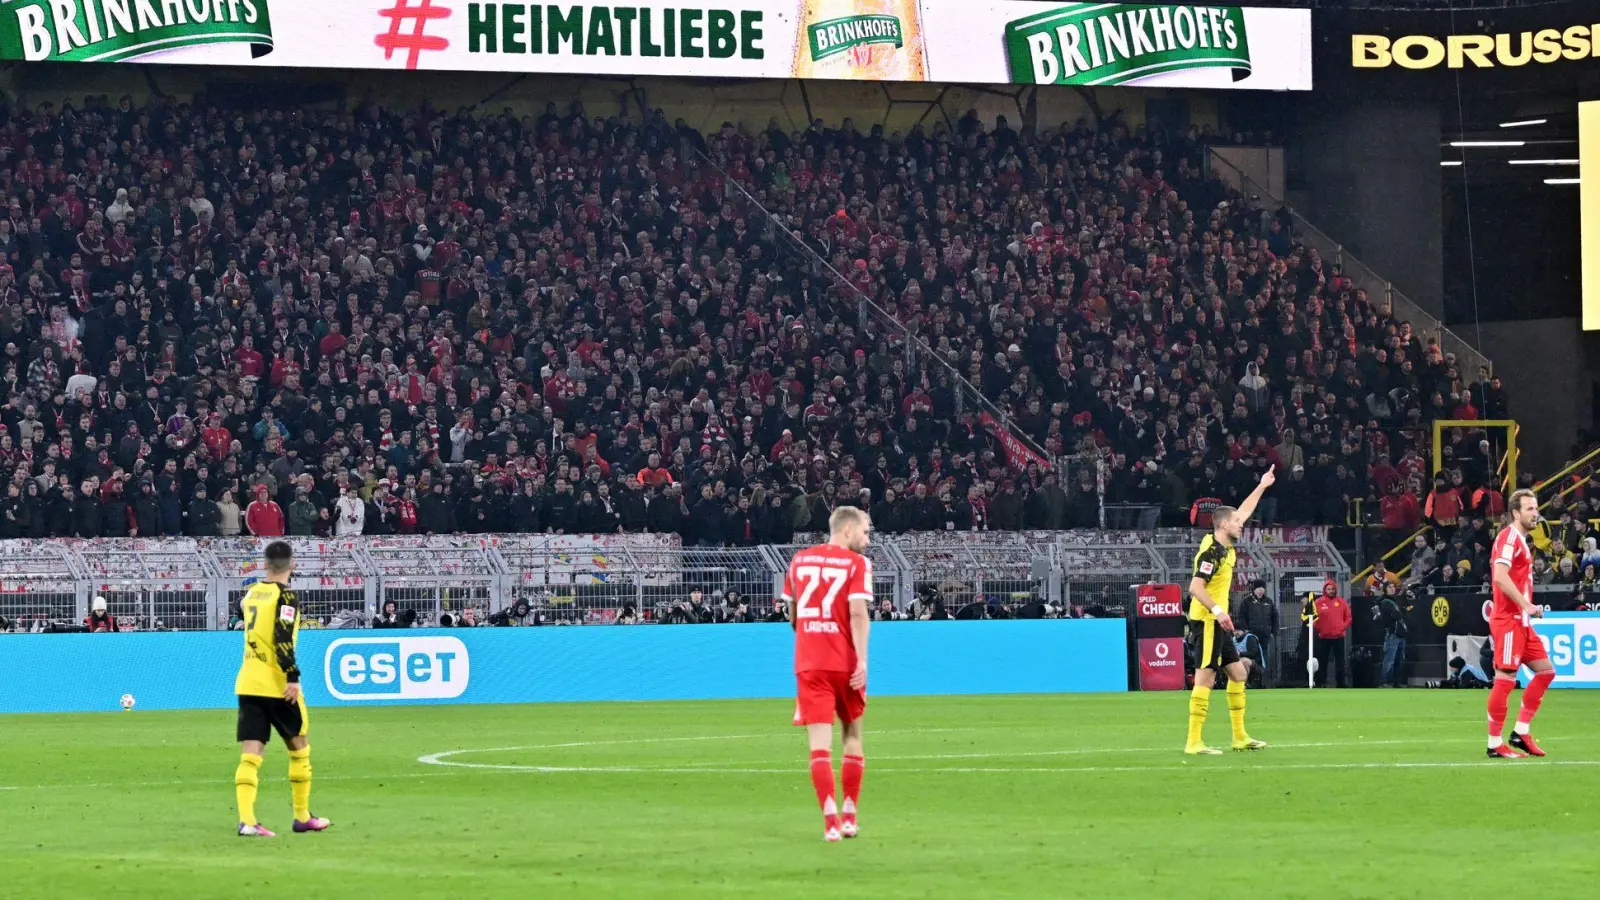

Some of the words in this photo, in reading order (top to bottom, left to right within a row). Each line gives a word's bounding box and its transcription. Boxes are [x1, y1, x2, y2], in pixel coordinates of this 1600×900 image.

[468, 3, 764, 59] HEIMATLIEBE
[1026, 5, 1238, 84] BRINKHOFF's
[796, 566, 848, 619] 27
[1142, 603, 1180, 615] CHECK
[247, 605, 257, 630] 7
[1149, 659, 1176, 667] vodafone
